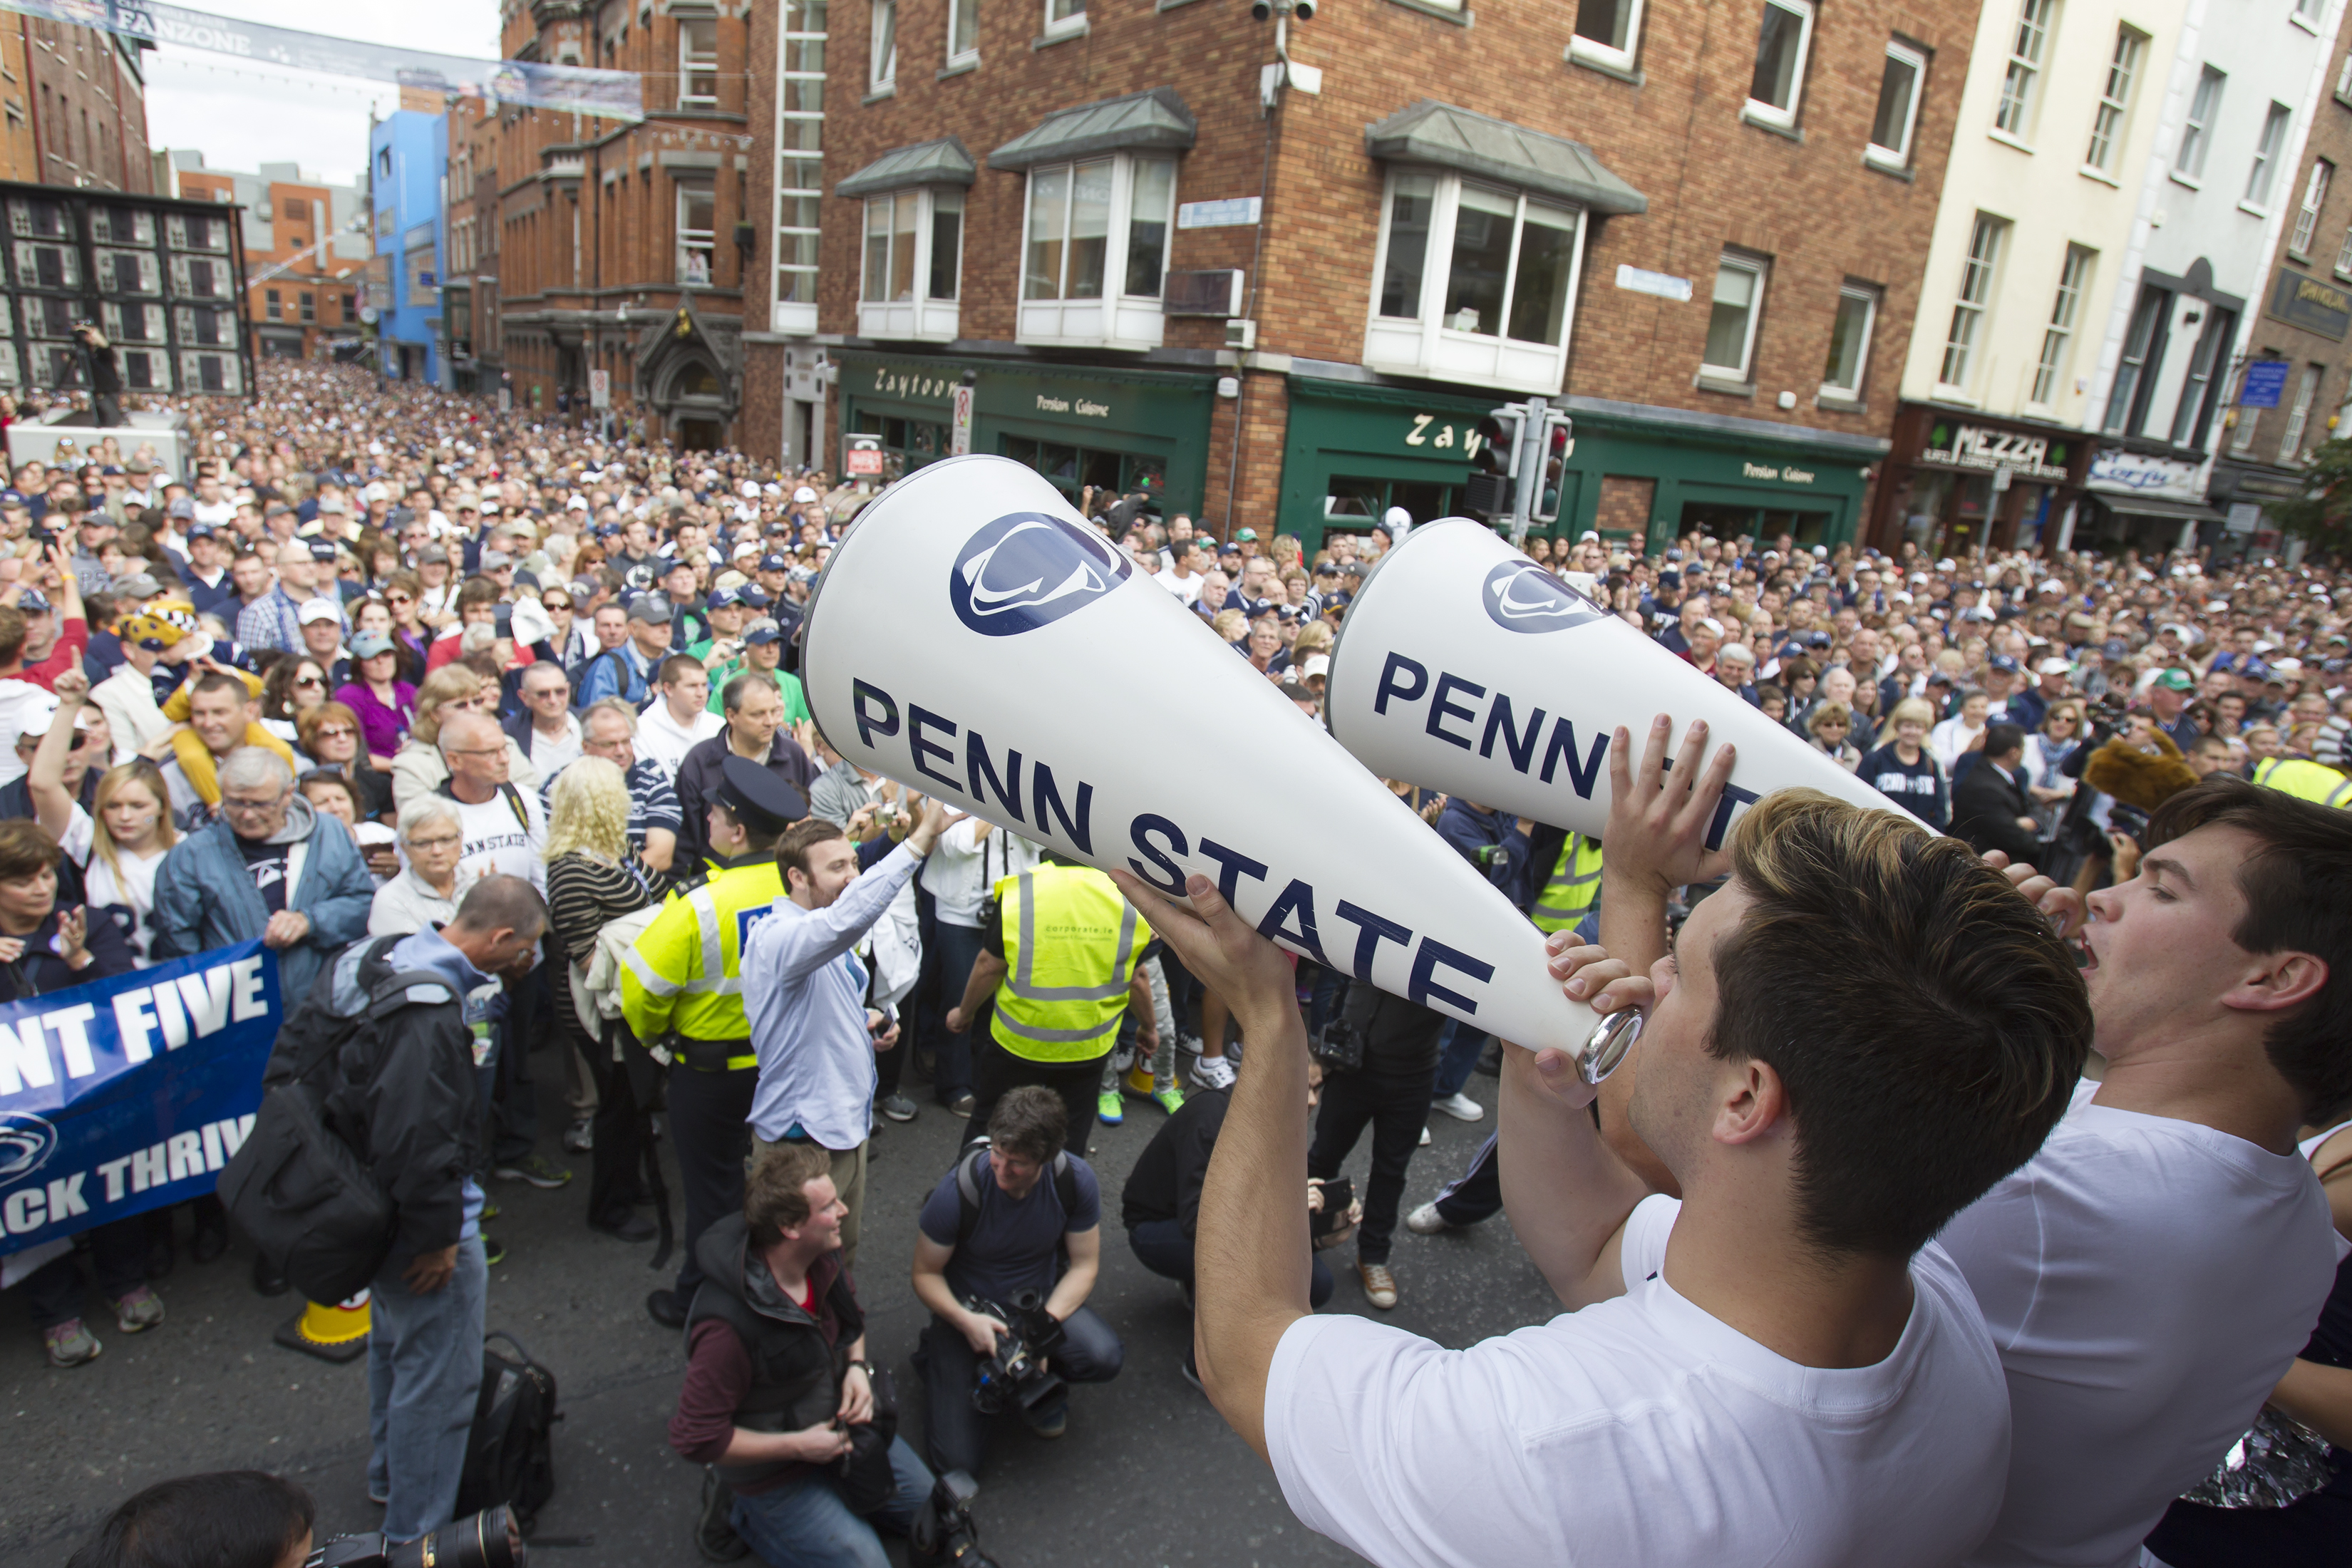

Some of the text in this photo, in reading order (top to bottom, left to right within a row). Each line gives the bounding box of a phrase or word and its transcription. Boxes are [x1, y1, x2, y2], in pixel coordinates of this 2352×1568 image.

[115, 7, 252, 56] FANZONE
[1951, 424, 2048, 476] MEZZA
[1374, 651, 1611, 800] PENN
[488, 833, 526, 850] STATE
[853, 677, 1495, 1016] PENN STATE
[1046, 925, 1113, 934] corporate.ie
[111, 954, 269, 1063] FIVE
